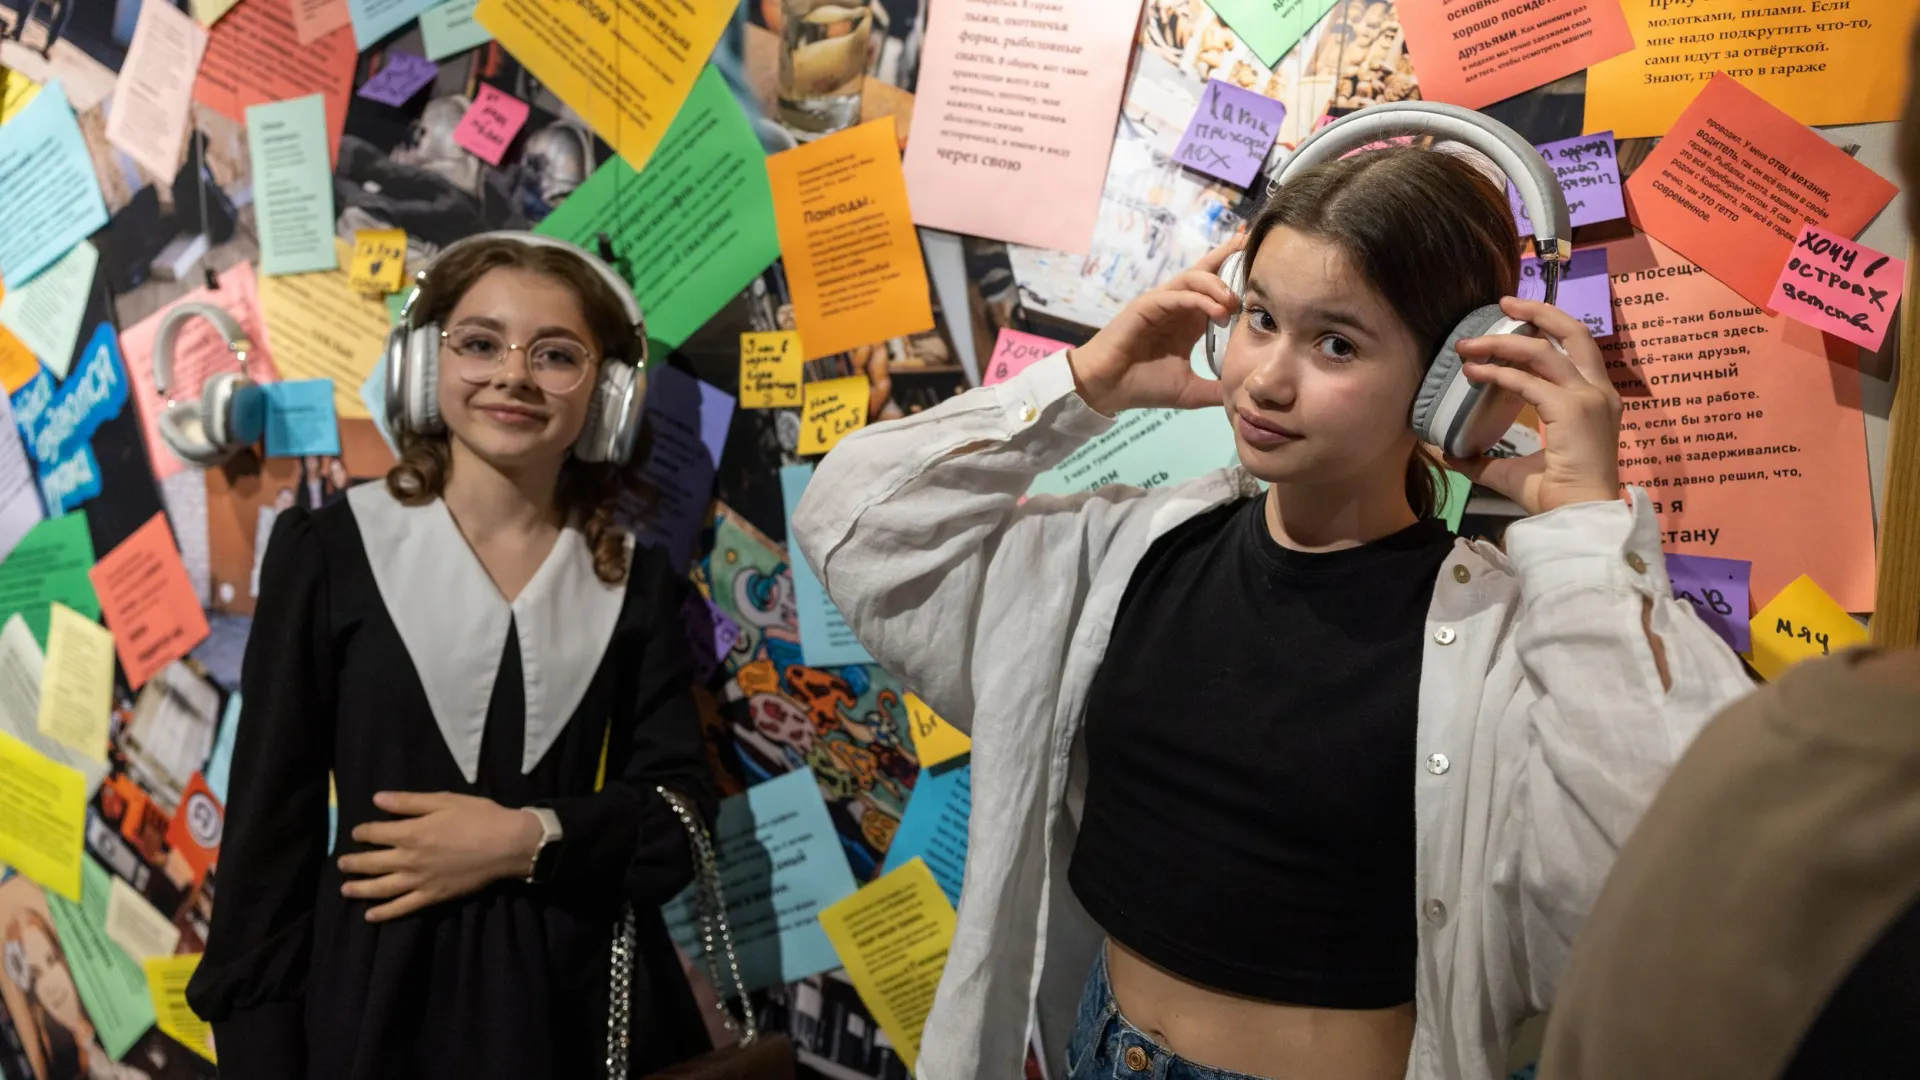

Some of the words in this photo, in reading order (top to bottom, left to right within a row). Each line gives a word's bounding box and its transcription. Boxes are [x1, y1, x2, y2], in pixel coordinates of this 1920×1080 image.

[1520, 25, 1536, 35] Как
[1536, 10, 1572, 29] минимум
[1572, 5, 1587, 16] раз
[1648, 11, 1737, 28] молотками,
[1741, 5, 1806, 19] пилами.
[1811, 0, 1850, 13] Если
[1452, 15, 1499, 41] хорошо
[1647, 36, 1675, 46] мне
[1679, 32, 1715, 44] надо
[1719, 24, 1812, 41] подкрутить
[1816, 19, 1872, 32] что-то,
[958, 29, 999, 46] форма,
[1002, 36, 1083, 55] рыболовные
[1468, 54, 1496, 70] неделю
[1496, 49, 1510, 58] мы
[1509, 40, 1532, 53] точно
[1532, 25, 1571, 45] заезжаем
[1570, 17, 1592, 30] сюда
[1497, 56, 1522, 70] чтобы
[1521, 42, 1562, 61] осмотреть
[1561, 29, 1593, 46] машину
[1644, 55, 1680, 66] сами
[1684, 51, 1722, 65] идут
[1724, 49, 1740, 59] за
[1743, 41, 1829, 59] отвёрткой.
[1644, 73, 1695, 85] Знают,
[1699, 71, 1714, 81] гд
[1727, 68, 1754, 78] что
[1758, 67, 1766, 76] в
[1770, 63, 1827, 78] гараже
[936, 147, 978, 164] через
[980, 155, 1022, 172] свою
[1706, 118, 1743, 145] проводил.
[1742, 139, 1752, 148] У
[1748, 145, 1769, 161] меня
[1767, 157, 1791, 177] отец
[1789, 171, 1831, 203] механик,
[1679, 148, 1693, 161] это
[1691, 156, 1708, 169] всё
[1704, 165, 1746, 195] перебирает
[1744, 192, 1769, 211] потом.
[1769, 206, 1779, 216] Я
[1776, 212, 1792, 225] сам
[1687, 139, 1713, 159] гараже.
[1712, 155, 1746, 182] Рыбалка,
[1746, 178, 1769, 197] охота,
[1769, 193, 1799, 215] машина
[1803, 215, 1820, 227] вот
[1695, 129, 1739, 163] водитель,
[1740, 158, 1754, 170] так
[1752, 167, 1763, 177] он
[1762, 173, 1778, 186] всё
[1775, 182, 1800, 201] время
[1805, 201, 1830, 220] своём
[1661, 169, 1684, 188] вечно,
[1684, 183, 1699, 196] там
[1697, 192, 1715, 206] это
[1714, 202, 1740, 222] гетто
[1670, 158, 1696, 176] родом
[1693, 172, 1701, 180] с
[1699, 175, 1738, 206] Комбината,
[1739, 202, 1753, 214] там
[1752, 211, 1769, 224] всё
[1611, 272, 1630, 284] то
[1613, 292, 1669, 307] еезде.
[1613, 317, 1638, 335] ока
[1641, 313, 1705, 329] всё-таки
[1708, 306, 1762, 320] больше
[1640, 330, 1719, 347] оставаться
[1723, 325, 1769, 338] здесь.
[1631, 351, 1694, 366] всё-таки
[1697, 345, 1751, 361] друзья,
[1650, 362, 1739, 386] отличный
[1622, 395, 1682, 412] лектив
[1685, 396, 1703, 406] на
[1706, 390, 1760, 406] работе.
[1617, 419, 1641, 434] аю,
[1644, 418, 1677, 429] если
[1681, 414, 1700, 426] бы
[1703, 412, 1742, 424] этого
[1746, 409, 1764, 420] не
[1618, 440, 1631, 450] о,
[1634, 437, 1656, 450] тут
[1660, 434, 1679, 446] бы
[1683, 435, 1692, 444] и
[1695, 431, 1738, 443] люди,
[1617, 455, 1663, 469] ерное,
[1665, 454, 1682, 464] не
[1686, 444, 1801, 462] задерживались.
[1638, 475, 1670, 488] себя
[1672, 475, 1715, 488] давно
[1719, 470, 1769, 485] решил,
[1773, 468, 1802, 478] что,
[1671, 500, 1684, 513] я
